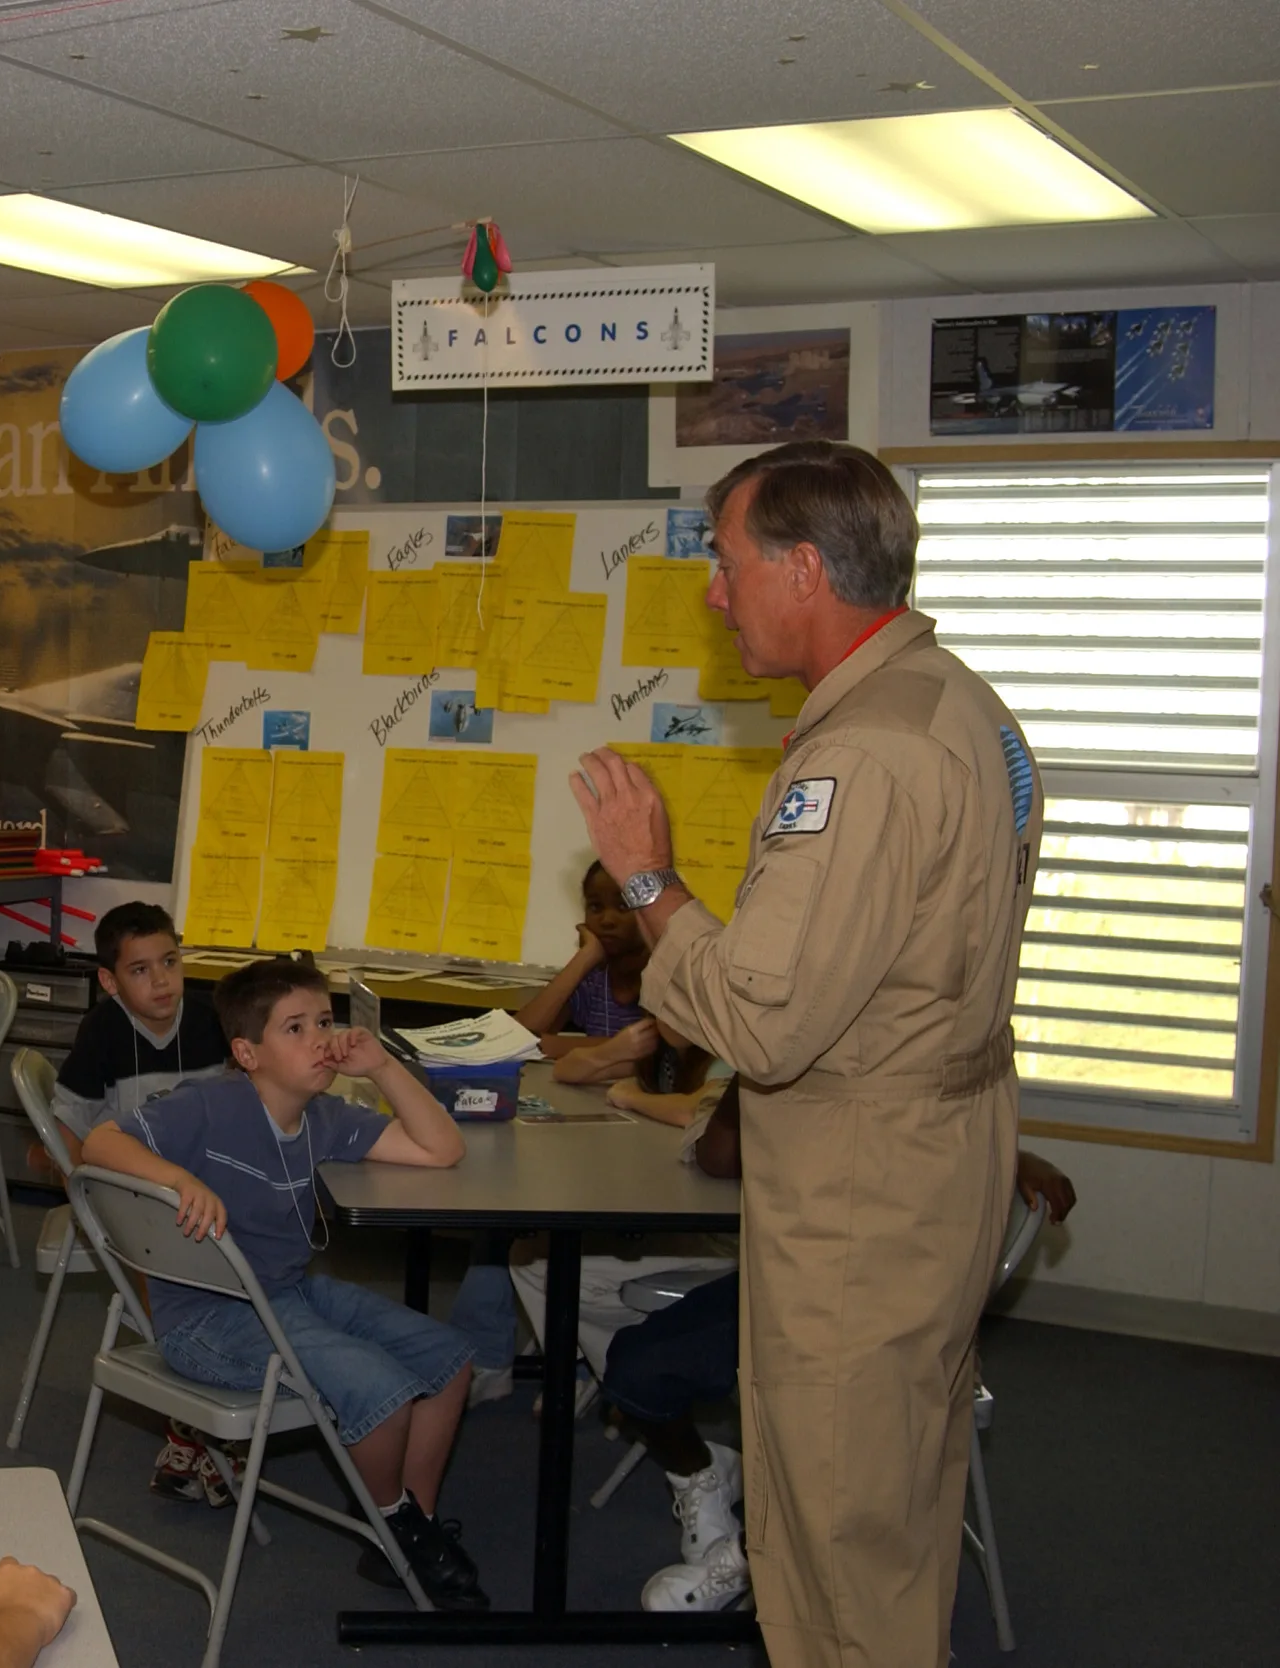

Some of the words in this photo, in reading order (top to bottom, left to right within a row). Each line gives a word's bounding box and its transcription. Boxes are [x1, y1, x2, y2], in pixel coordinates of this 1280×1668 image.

[448, 321, 649, 347] FALCONS
[387, 527, 433, 572] Eagles
[601, 520, 660, 580] Lancers
[195, 686, 271, 746] Thunderbolts
[368, 666, 440, 747] Blackbirds
[611, 667, 669, 721] Phantoms
